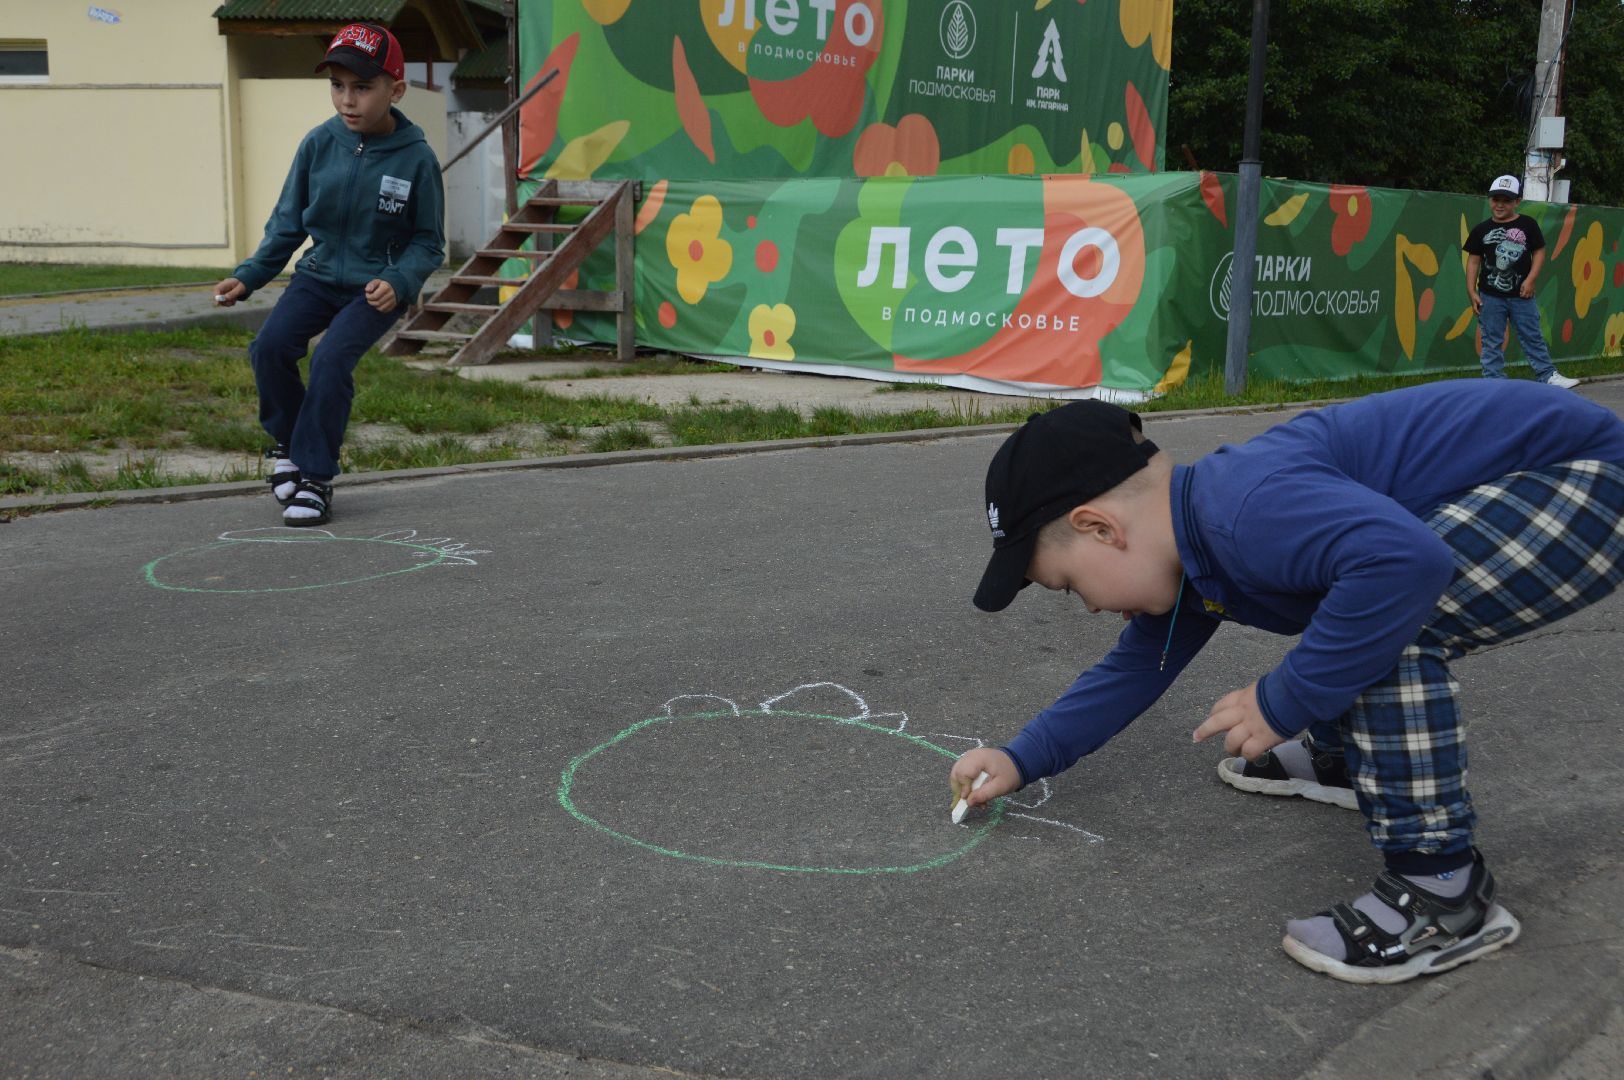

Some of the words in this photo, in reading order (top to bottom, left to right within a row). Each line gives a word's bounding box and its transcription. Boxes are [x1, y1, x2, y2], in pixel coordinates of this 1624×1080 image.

[738, 42, 746, 53] В
[754, 44, 857, 67] ПОДМОСКОВЬЕ
[936, 65, 975, 84] ПАРКИ
[909, 79, 996, 103] ПОДМОСКОВЬЯ
[1036, 85, 1061, 100] ПАРК
[1037, 99, 1069, 112] ГАГАРИНА
[857, 226, 1121, 298] лето
[882, 306, 892, 321] В
[904, 308, 1080, 332] ПОДМОСКОВЬЕ
